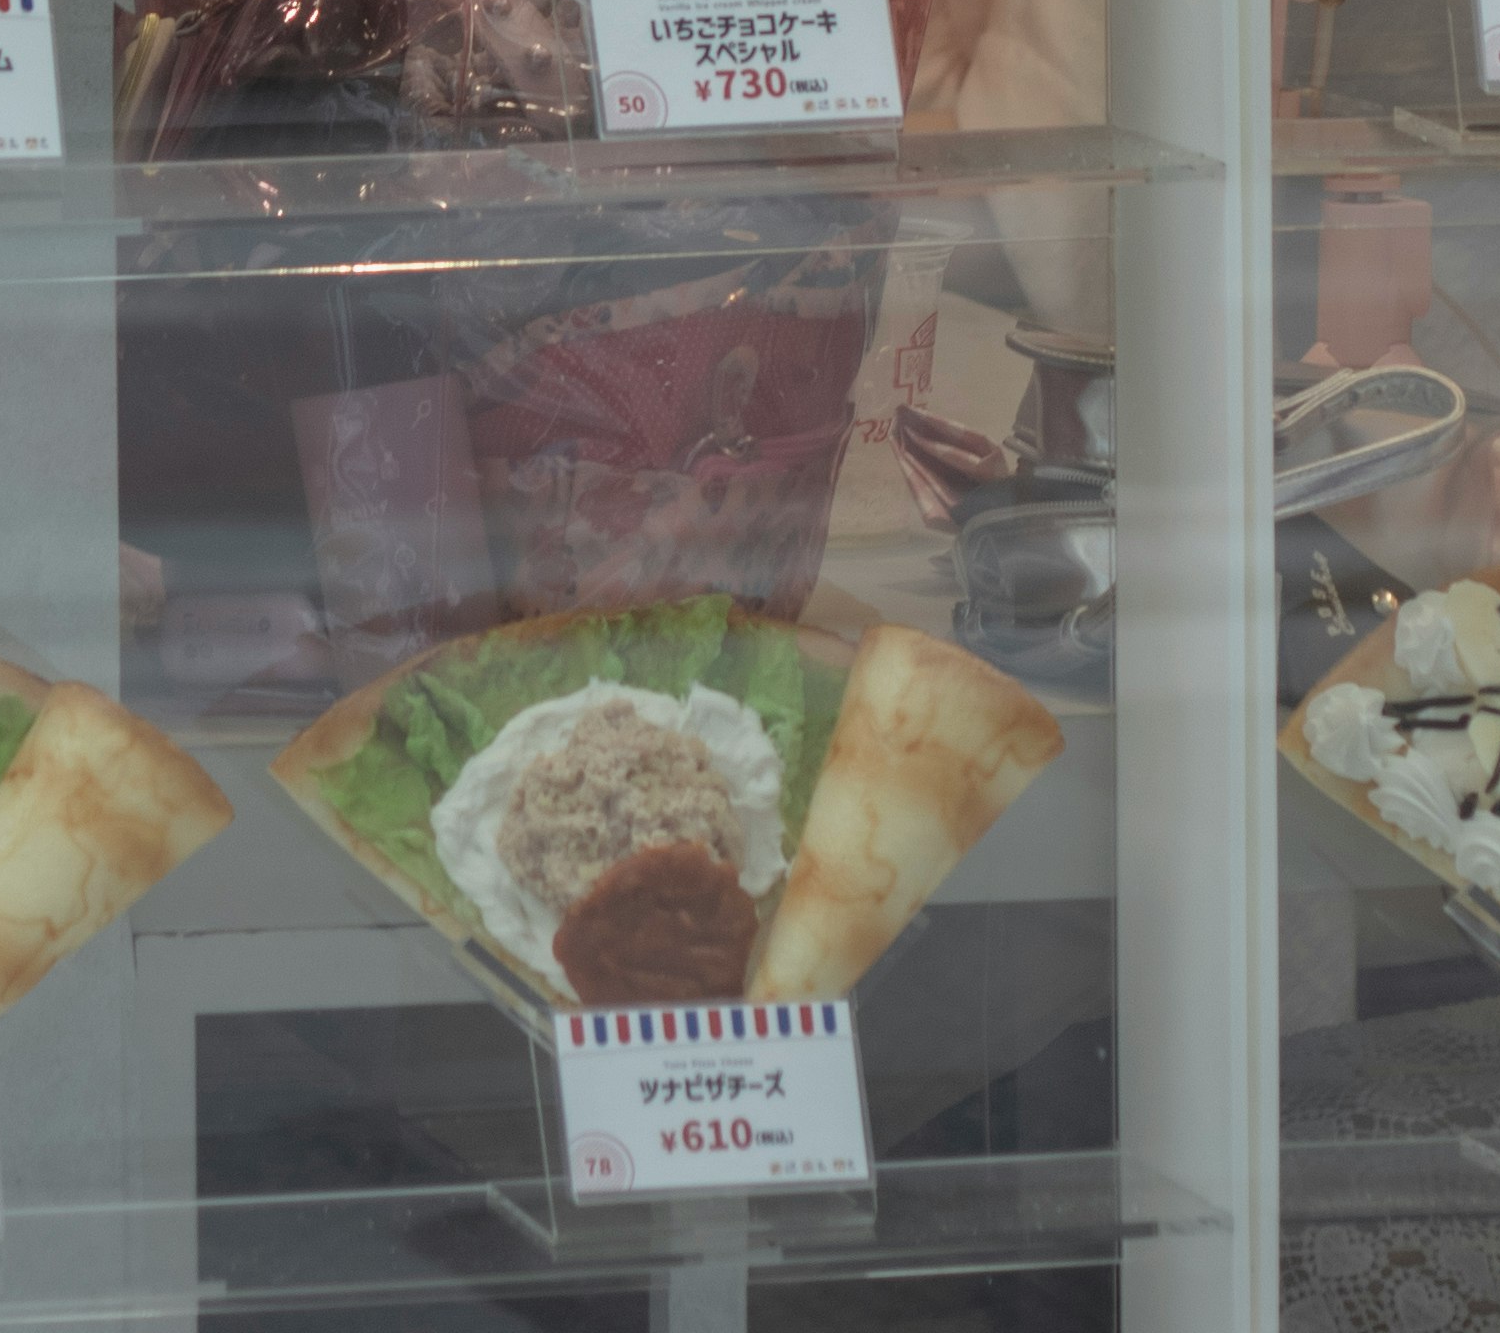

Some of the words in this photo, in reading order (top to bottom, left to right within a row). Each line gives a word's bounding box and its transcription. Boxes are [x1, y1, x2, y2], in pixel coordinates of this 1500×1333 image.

[651, 11, 837, 41] いちごチョコケーキ
[696, 40, 799, 67] スペシャル
[696, 68, 786, 101] ¥730
[618, 97, 645, 113] 50
[662, 1118, 751, 1154] ¥610
